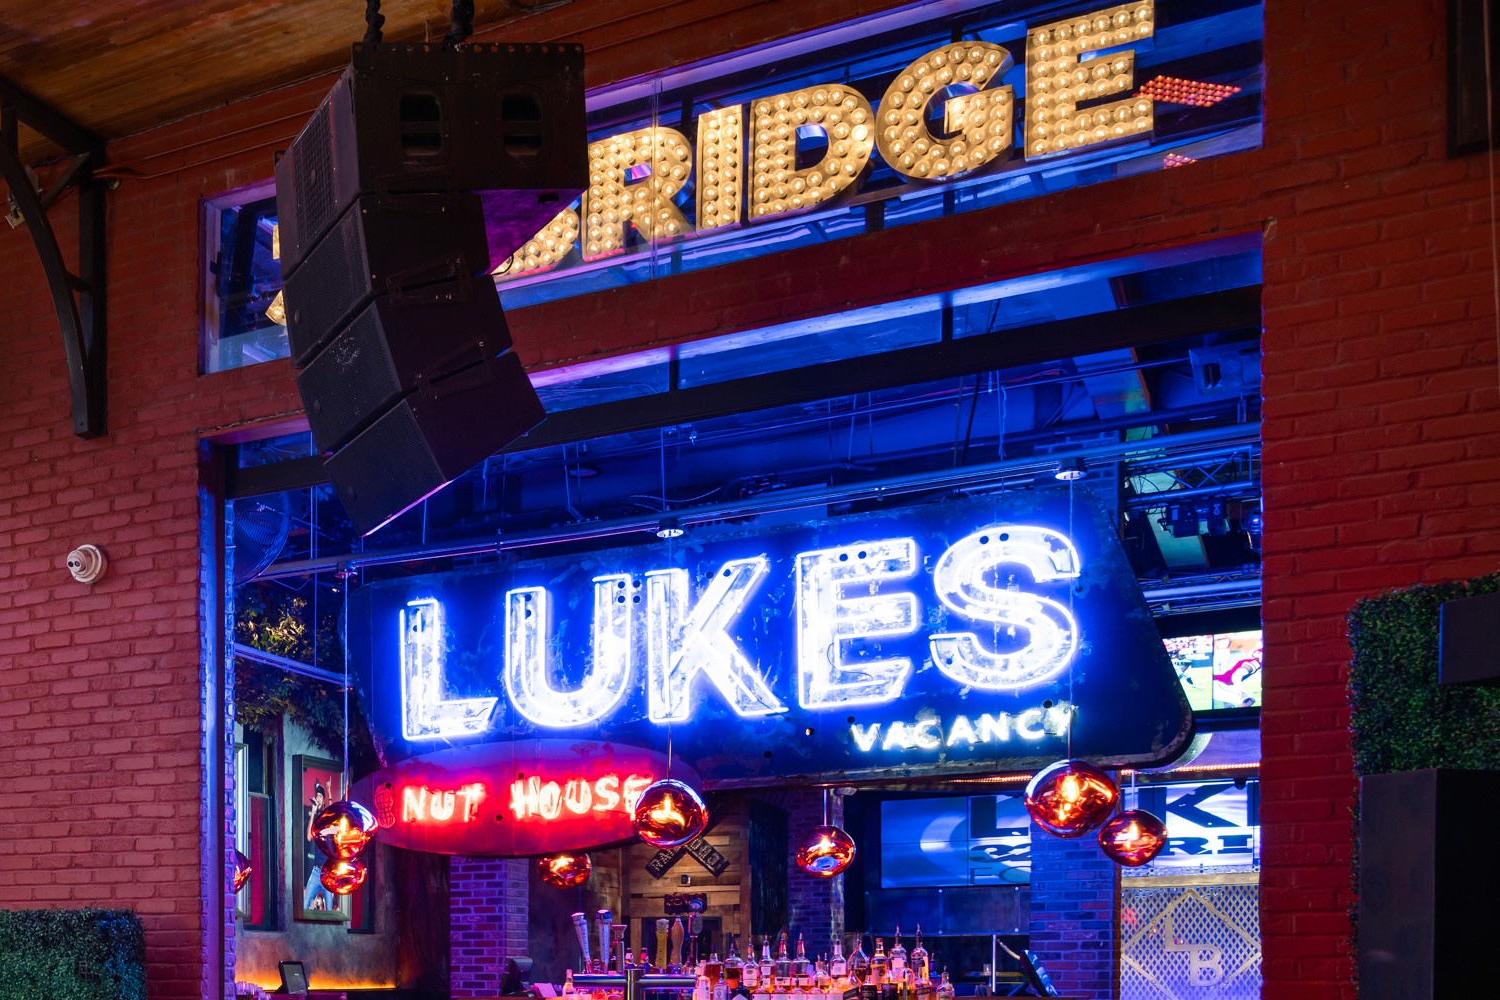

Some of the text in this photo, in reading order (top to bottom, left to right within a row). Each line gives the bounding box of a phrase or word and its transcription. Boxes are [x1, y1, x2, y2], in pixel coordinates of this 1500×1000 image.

[490, 0, 1155, 277] RIDGE
[398, 525, 1083, 741] LUKES
[850, 705, 1079, 752] VACANCY
[403, 783, 484, 823] NUT
